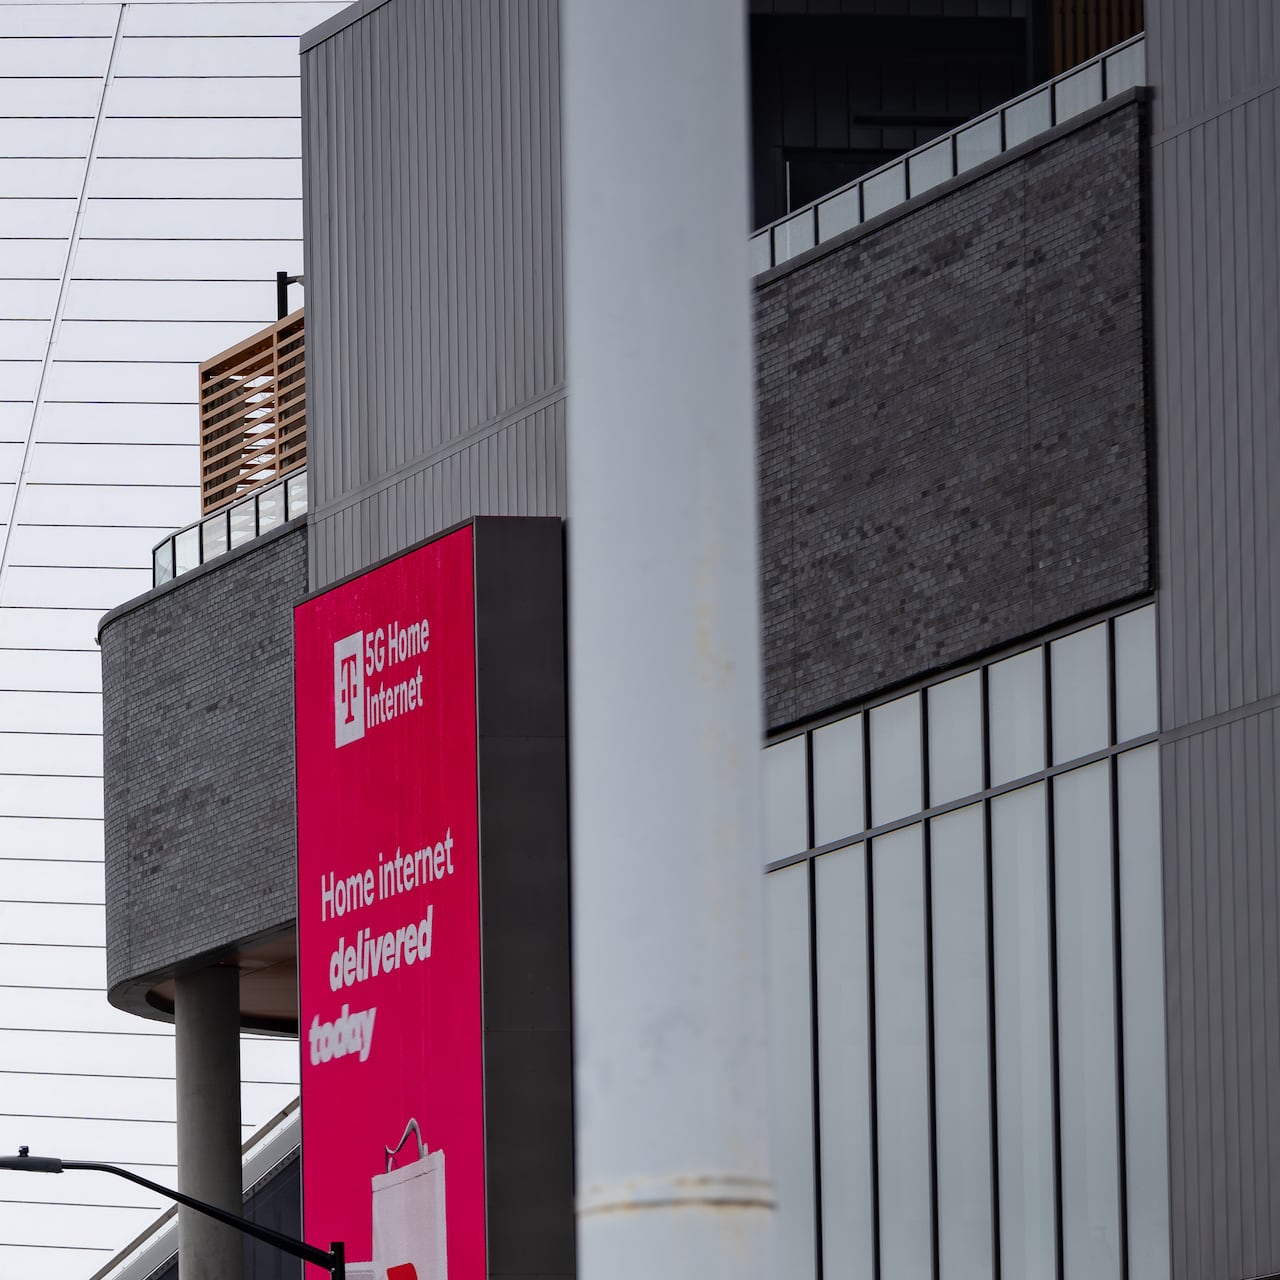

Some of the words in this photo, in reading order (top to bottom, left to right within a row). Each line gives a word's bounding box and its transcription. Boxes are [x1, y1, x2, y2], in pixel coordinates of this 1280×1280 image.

[366, 628, 385, 676] 5G
[388, 618, 430, 667] Home
[366, 665, 424, 729] Internet
[321, 868, 375, 922] Home
[378, 827, 454, 901] internet
[329, 904, 434, 992] delivered
[308, 1003, 377, 1066] today
